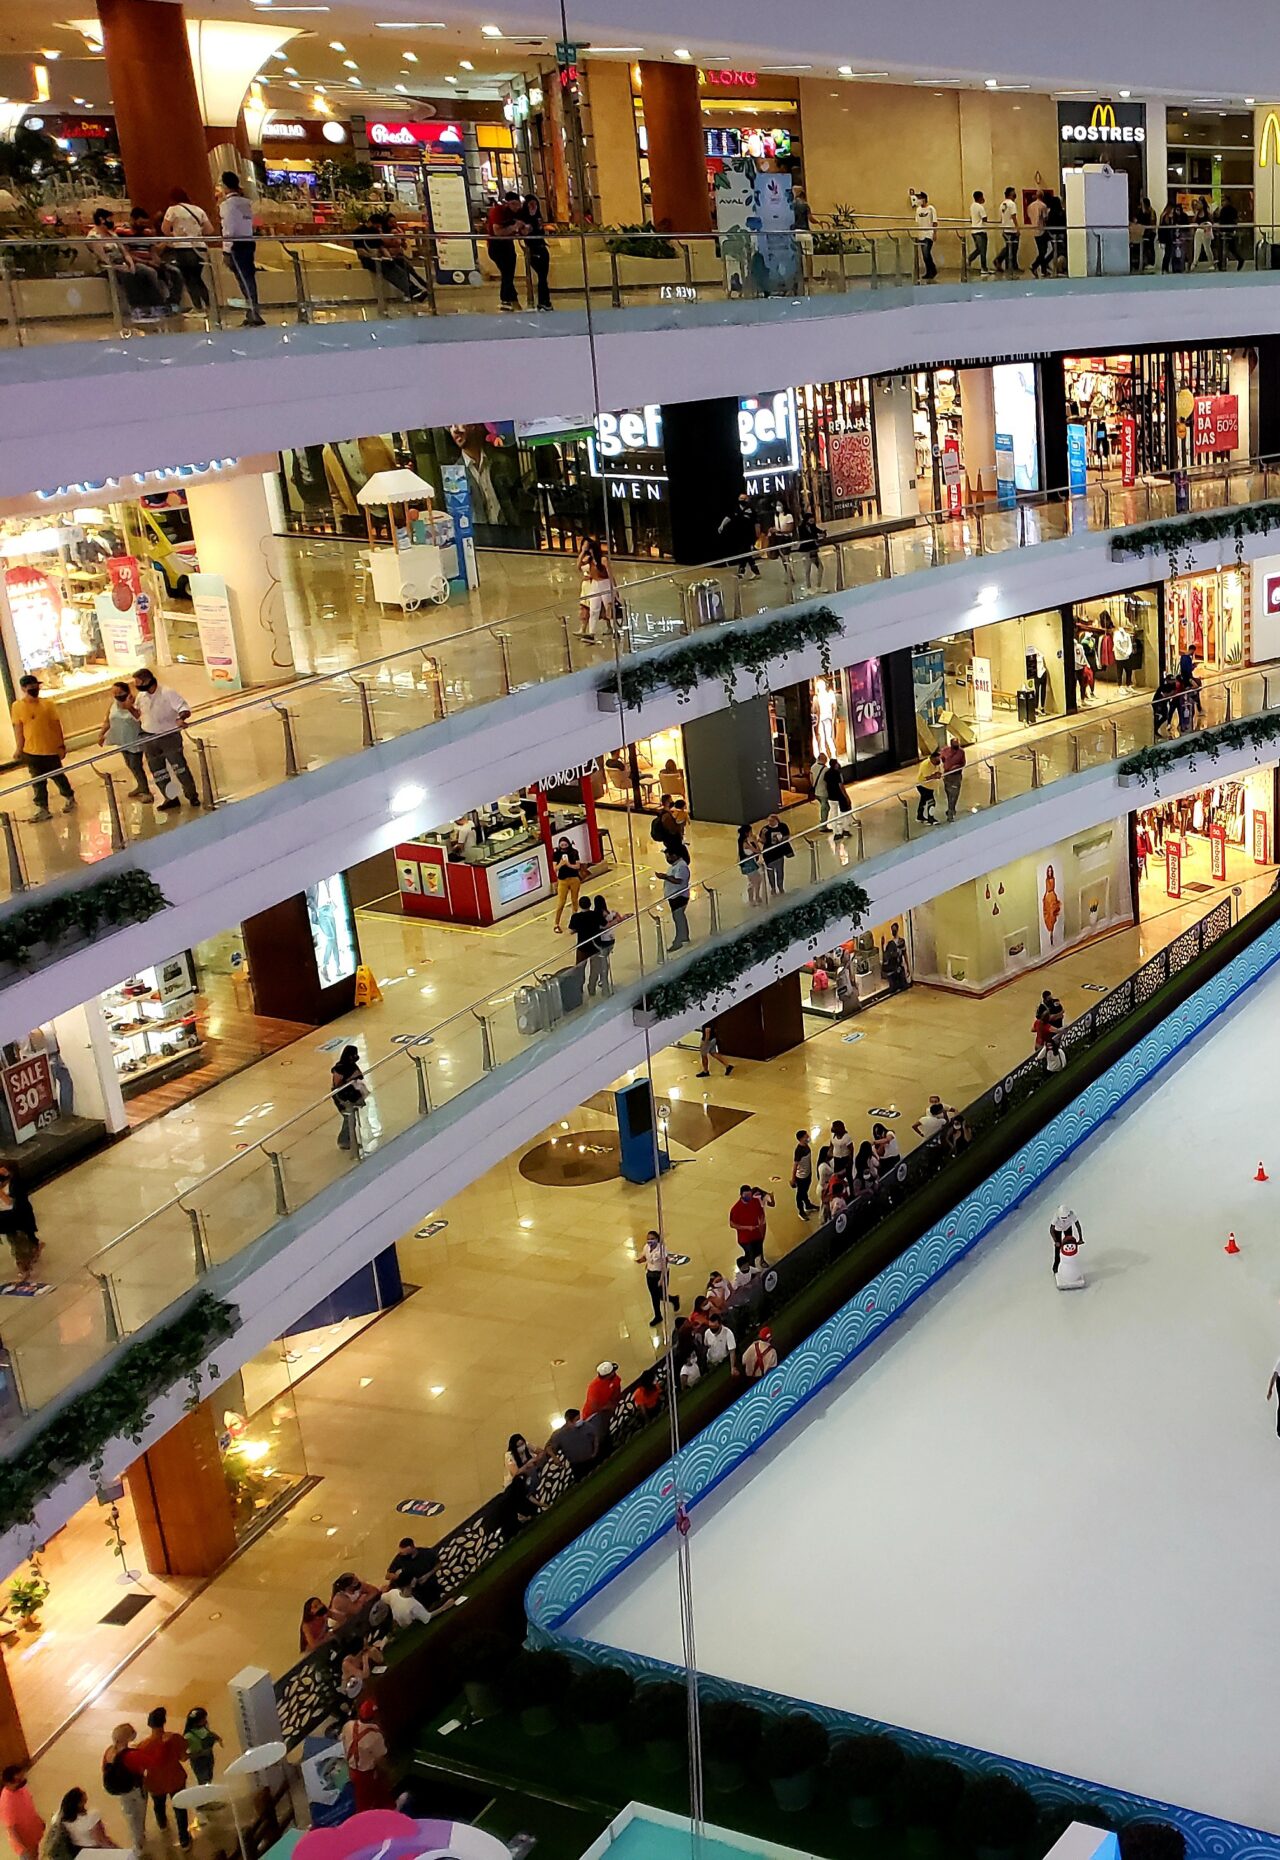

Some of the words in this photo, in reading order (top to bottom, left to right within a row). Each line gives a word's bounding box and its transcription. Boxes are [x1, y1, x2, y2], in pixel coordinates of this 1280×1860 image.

[1061, 125, 1146, 142] POSTRES
[1197, 401, 1212, 415] RE
[594, 405, 663, 456] gef
[738, 393, 788, 455] gef
[1197, 418, 1212, 430] BA
[1195, 434, 1216, 446] JAS
[612, 482, 661, 500] MEN
[746, 475, 786, 496] MEN
[975, 677, 991, 693] SALE
[538, 757, 600, 793] MOMOTEA
[1170, 856, 1178, 892] Rebajas
[10, 1062, 45, 1093] SALE
